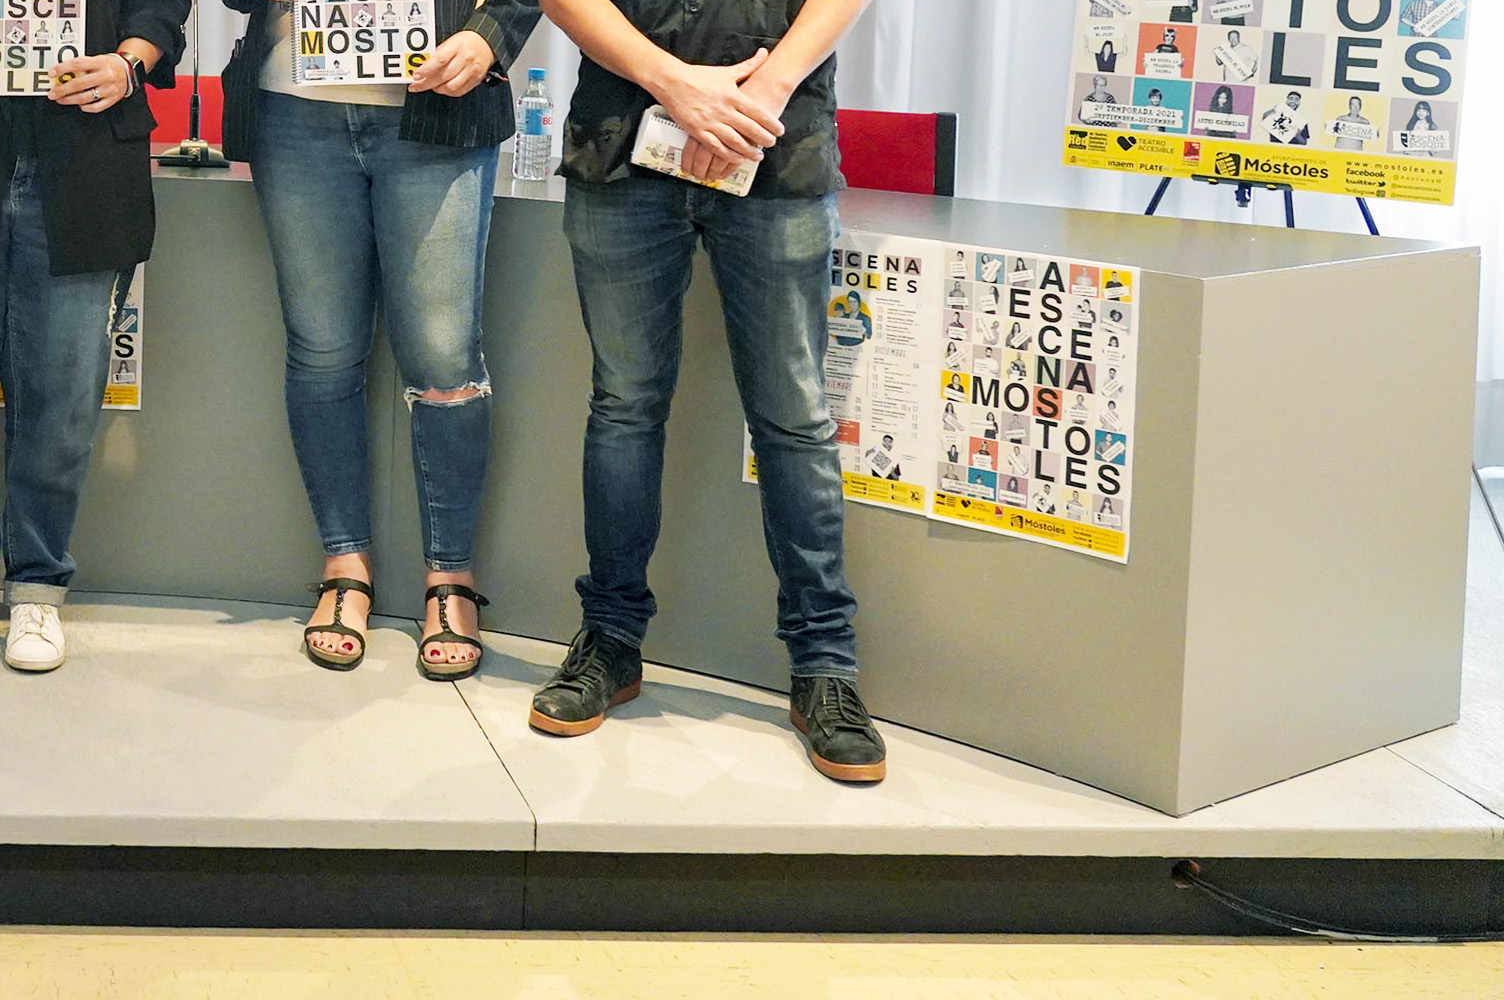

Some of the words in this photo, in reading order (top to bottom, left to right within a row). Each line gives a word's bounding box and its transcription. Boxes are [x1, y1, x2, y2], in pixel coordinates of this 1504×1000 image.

[1106, 105, 1154, 116] TEMPORADA
[1156, 110, 1176, 118] 2021
[1138, 138, 1167, 146] TEATRO
[1138, 144, 1174, 154] ACCESIBLE
[1244, 158, 1330, 179] Móstoles
[1346, 168, 1385, 178] facebook
[1040, 262, 1066, 292] A
[115, 334, 134, 358] S
